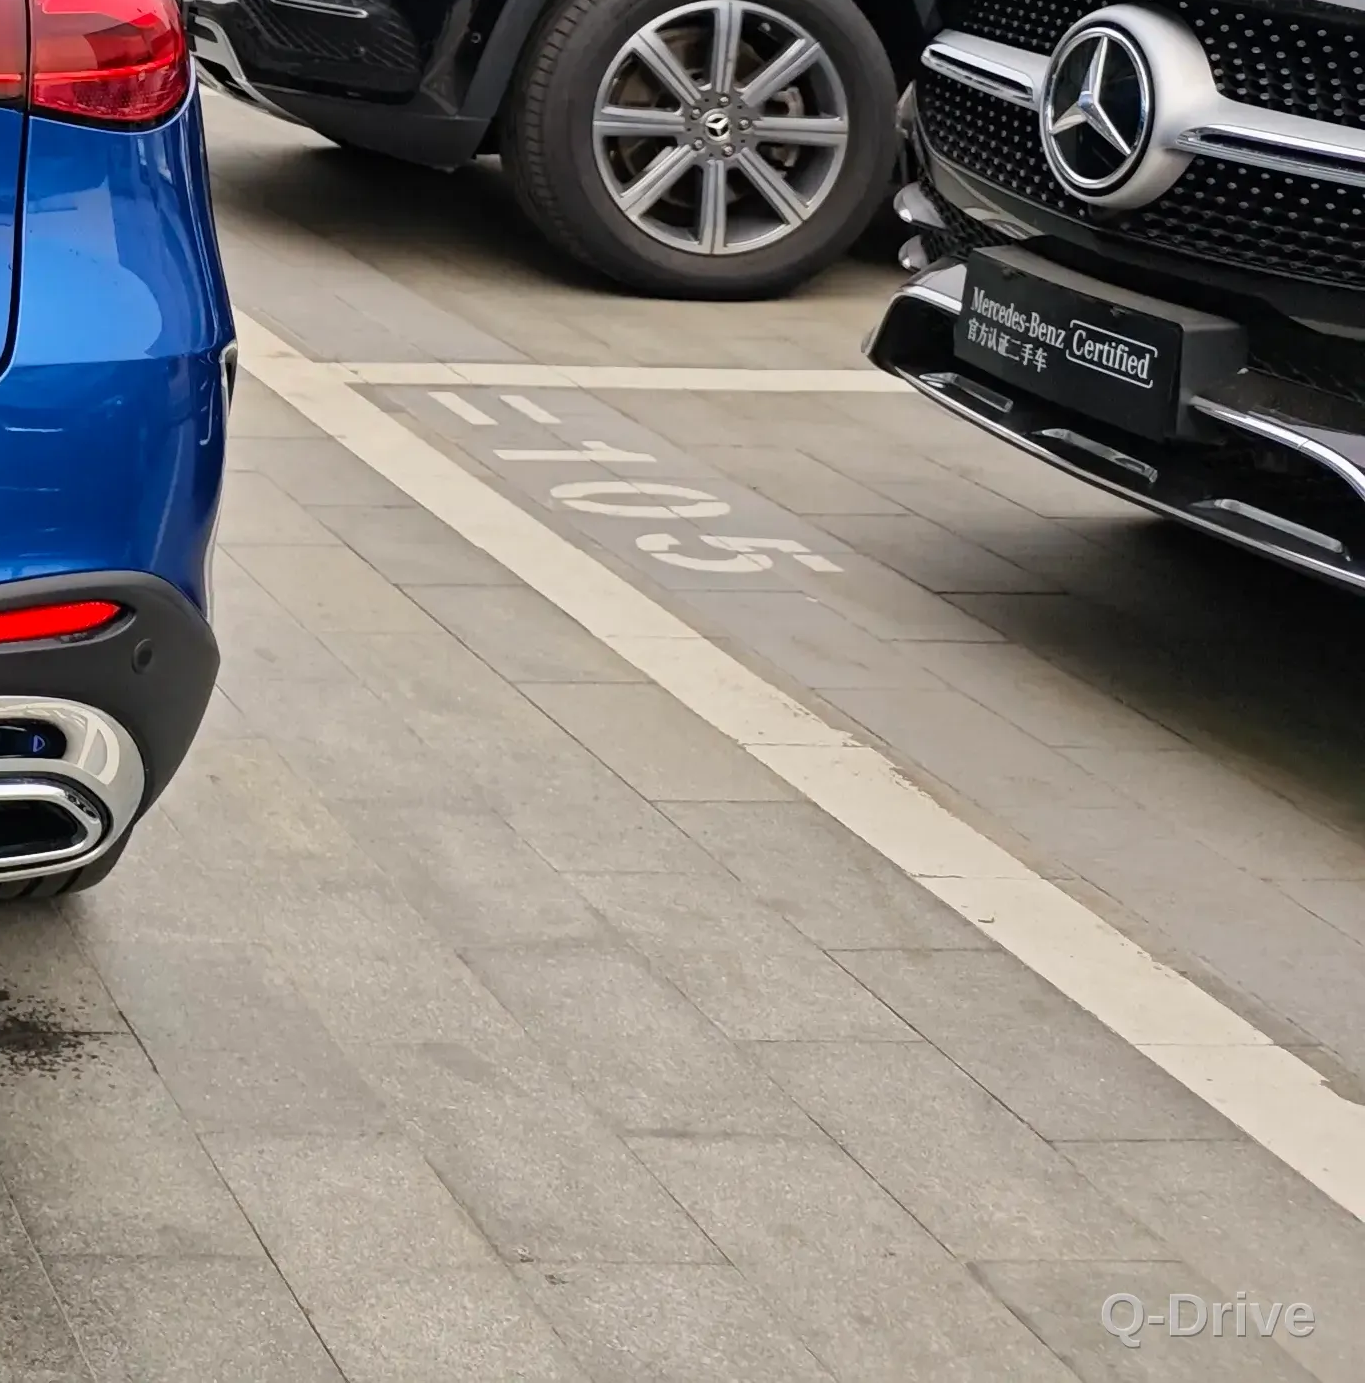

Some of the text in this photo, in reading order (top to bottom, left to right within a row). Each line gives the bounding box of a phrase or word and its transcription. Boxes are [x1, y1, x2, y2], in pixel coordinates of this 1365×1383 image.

[967, 318, 1048, 373] 官方认证二手车
[970, 287, 1151, 379] Mercedes-Benz Certified
